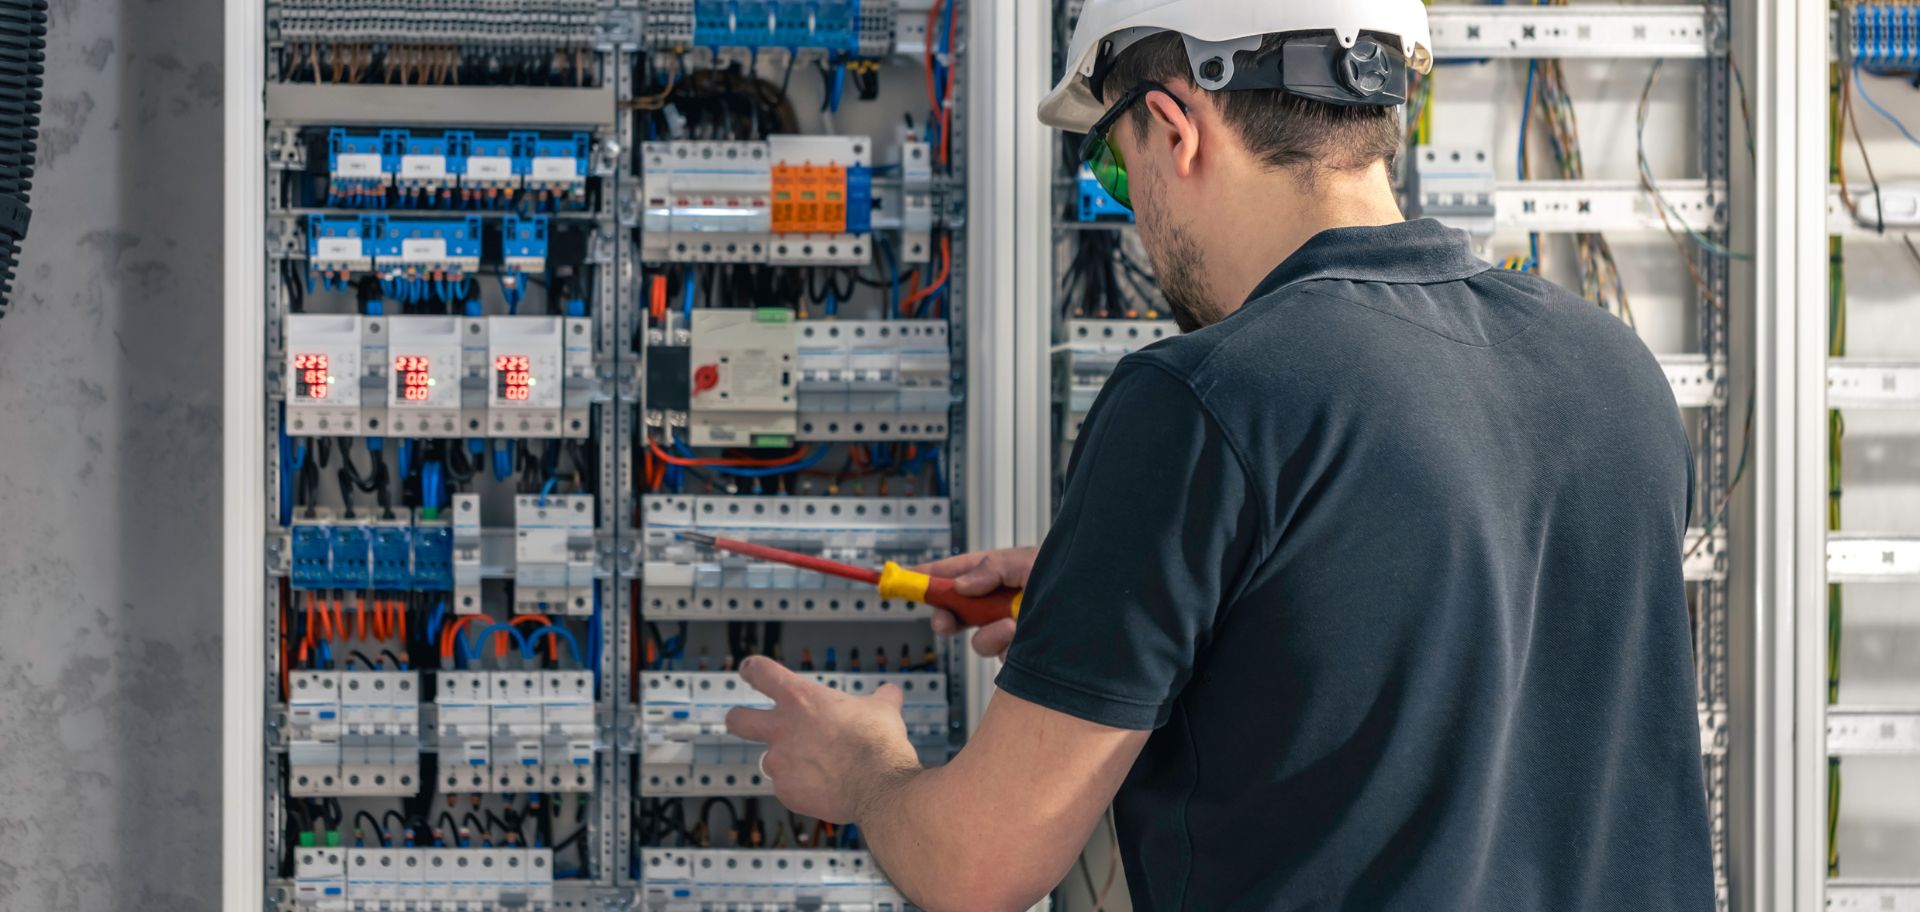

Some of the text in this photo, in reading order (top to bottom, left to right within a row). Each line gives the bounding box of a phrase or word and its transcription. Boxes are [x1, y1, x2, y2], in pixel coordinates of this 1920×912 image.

[294, 353, 328, 369] 225
[394, 355, 429, 371] 232
[495, 355, 530, 371] 225
